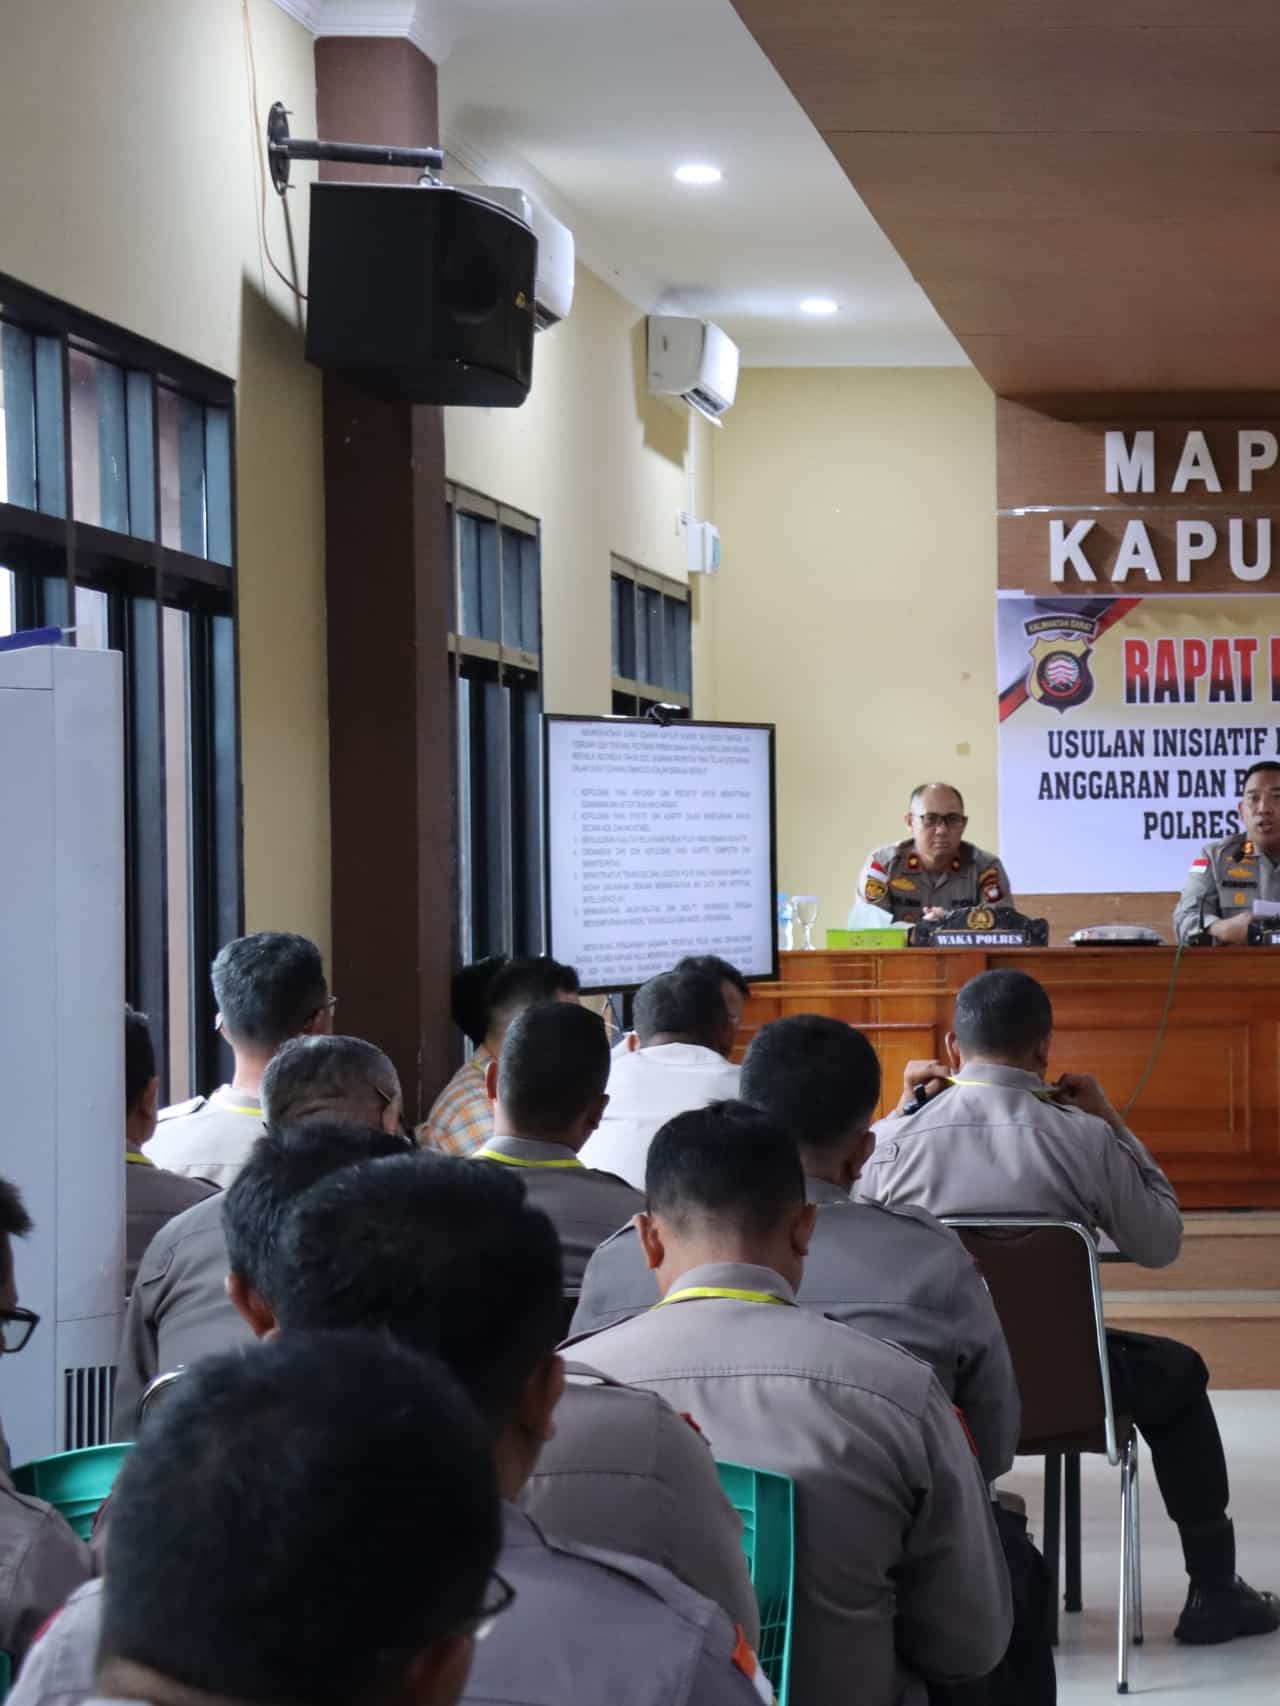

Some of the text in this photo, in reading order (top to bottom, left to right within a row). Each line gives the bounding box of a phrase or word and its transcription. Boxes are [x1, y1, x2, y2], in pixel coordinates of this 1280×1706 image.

[1124, 638, 1258, 704] RAPAT
[1048, 729, 1146, 758] USULAN
[1153, 727, 1268, 757] INISIATIF
[1038, 769, 1169, 800] ANGGARAN
[1177, 769, 1227, 798] DAN
[1143, 810, 1240, 840] POLRES
[937, 933, 1023, 945] WAKA POLRES
